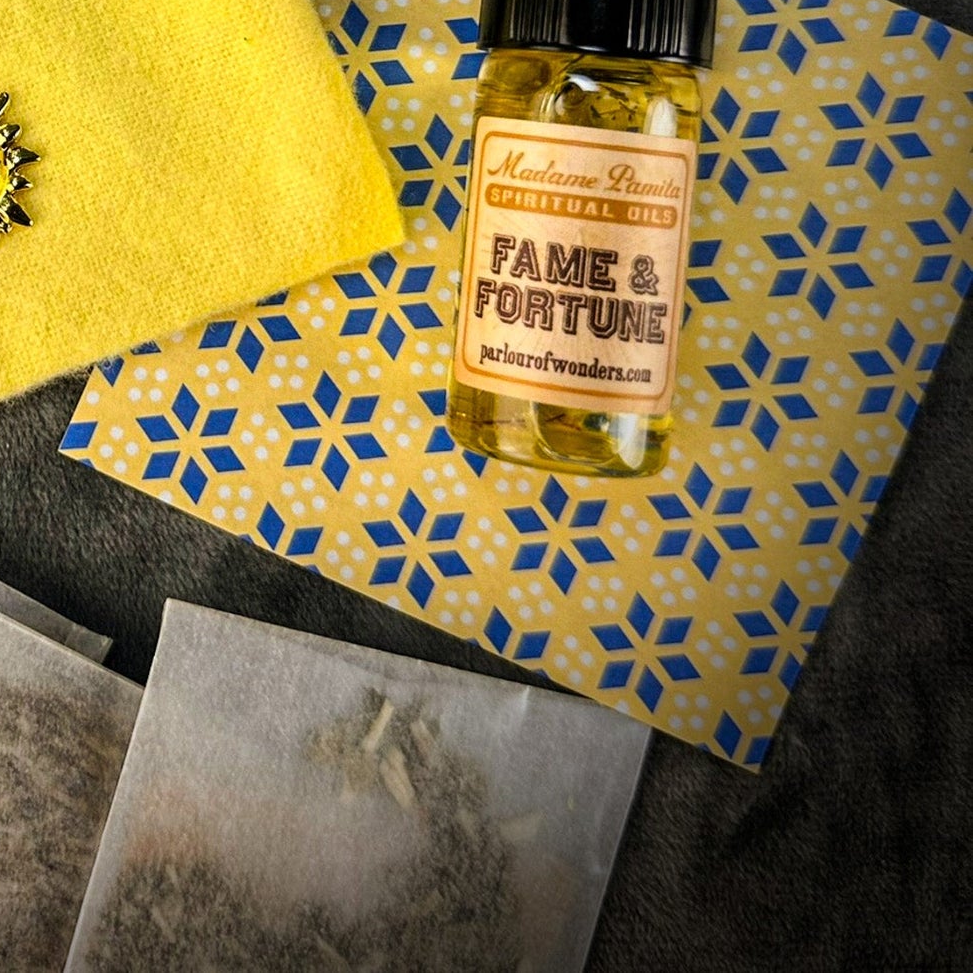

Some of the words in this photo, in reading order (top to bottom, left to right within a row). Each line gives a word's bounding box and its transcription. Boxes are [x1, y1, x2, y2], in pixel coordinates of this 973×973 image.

[487, 150, 598, 190] Madame
[604, 163, 681, 199] Pamita
[490, 189, 615, 219] SPIRITUAL
[627, 206, 674, 225] OILS
[490, 232, 619, 293] FAME
[629, 254, 659, 296] &
[474, 276, 668, 345] FORTUNE
[479, 343, 652, 383] parlourofwonders.com
